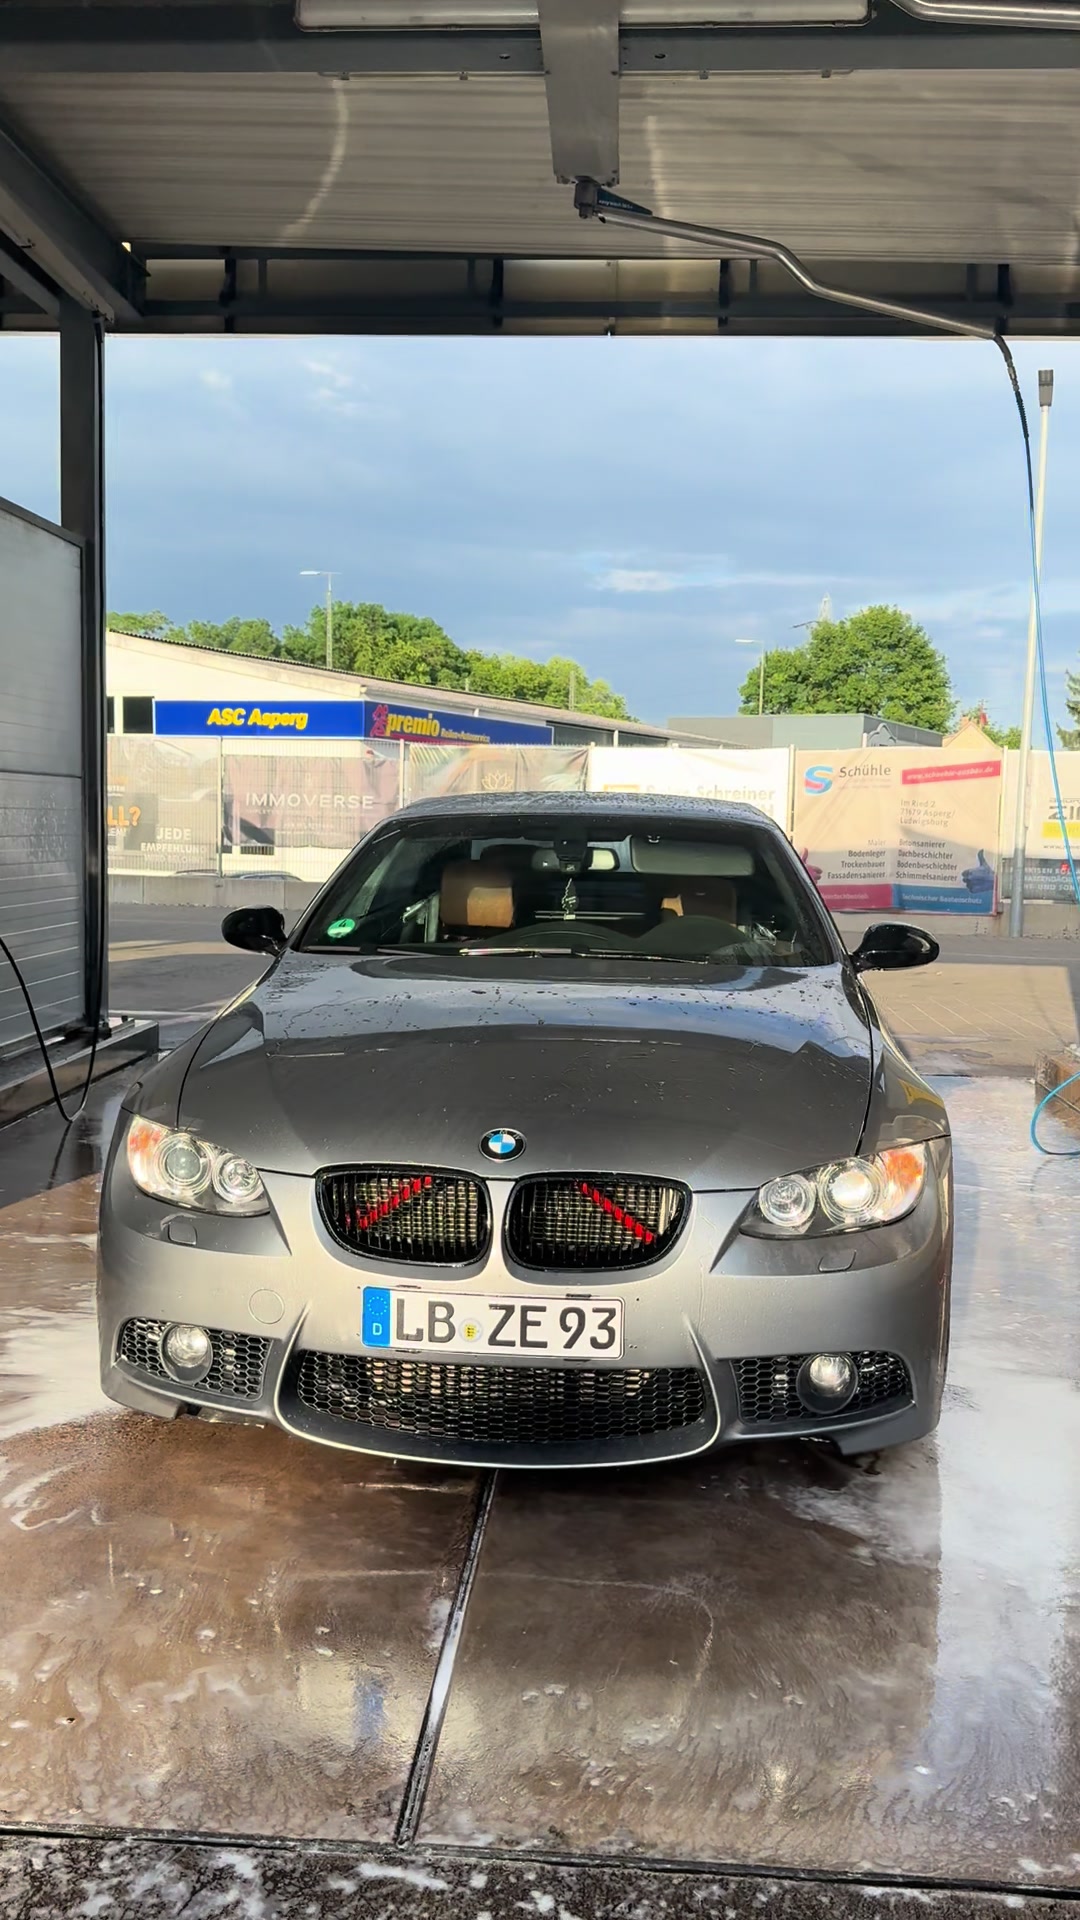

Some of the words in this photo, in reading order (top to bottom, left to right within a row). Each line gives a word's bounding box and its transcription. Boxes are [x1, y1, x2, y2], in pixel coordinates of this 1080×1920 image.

[207, 708, 246, 726] ASC
[247, 708, 309, 730] Asperg
[385, 713, 441, 737] premio
[838, 764, 892, 778] Schühle
[696, 785, 776, 801] Schreiner
[245, 791, 376, 809] IMMOVERSE
[911, 799, 929, 808] Ried
[930, 800, 936, 808] 2
[107, 806, 141, 827] LL?
[900, 808, 922, 816] 71679
[900, 816, 949, 828] Ludwigsburg
[156, 827, 192, 841] JEDE
[899, 838, 946, 848] Betonsanierer
[848, 849, 886, 859] Bodenleger
[898, 849, 953, 860] Dachbeschichter
[841, 860, 886, 869] Trockenbauer
[896, 860, 958, 871] Bodenbeschichter
[827, 870, 886, 880] Fassadensanierer
[895, 870, 958, 882] Schimmelsanierer
[372, 1322, 382, 1336] D
[395, 1297, 456, 1343] LB
[488, 1303, 548, 1349] ZE
[559, 1306, 616, 1350] 93
